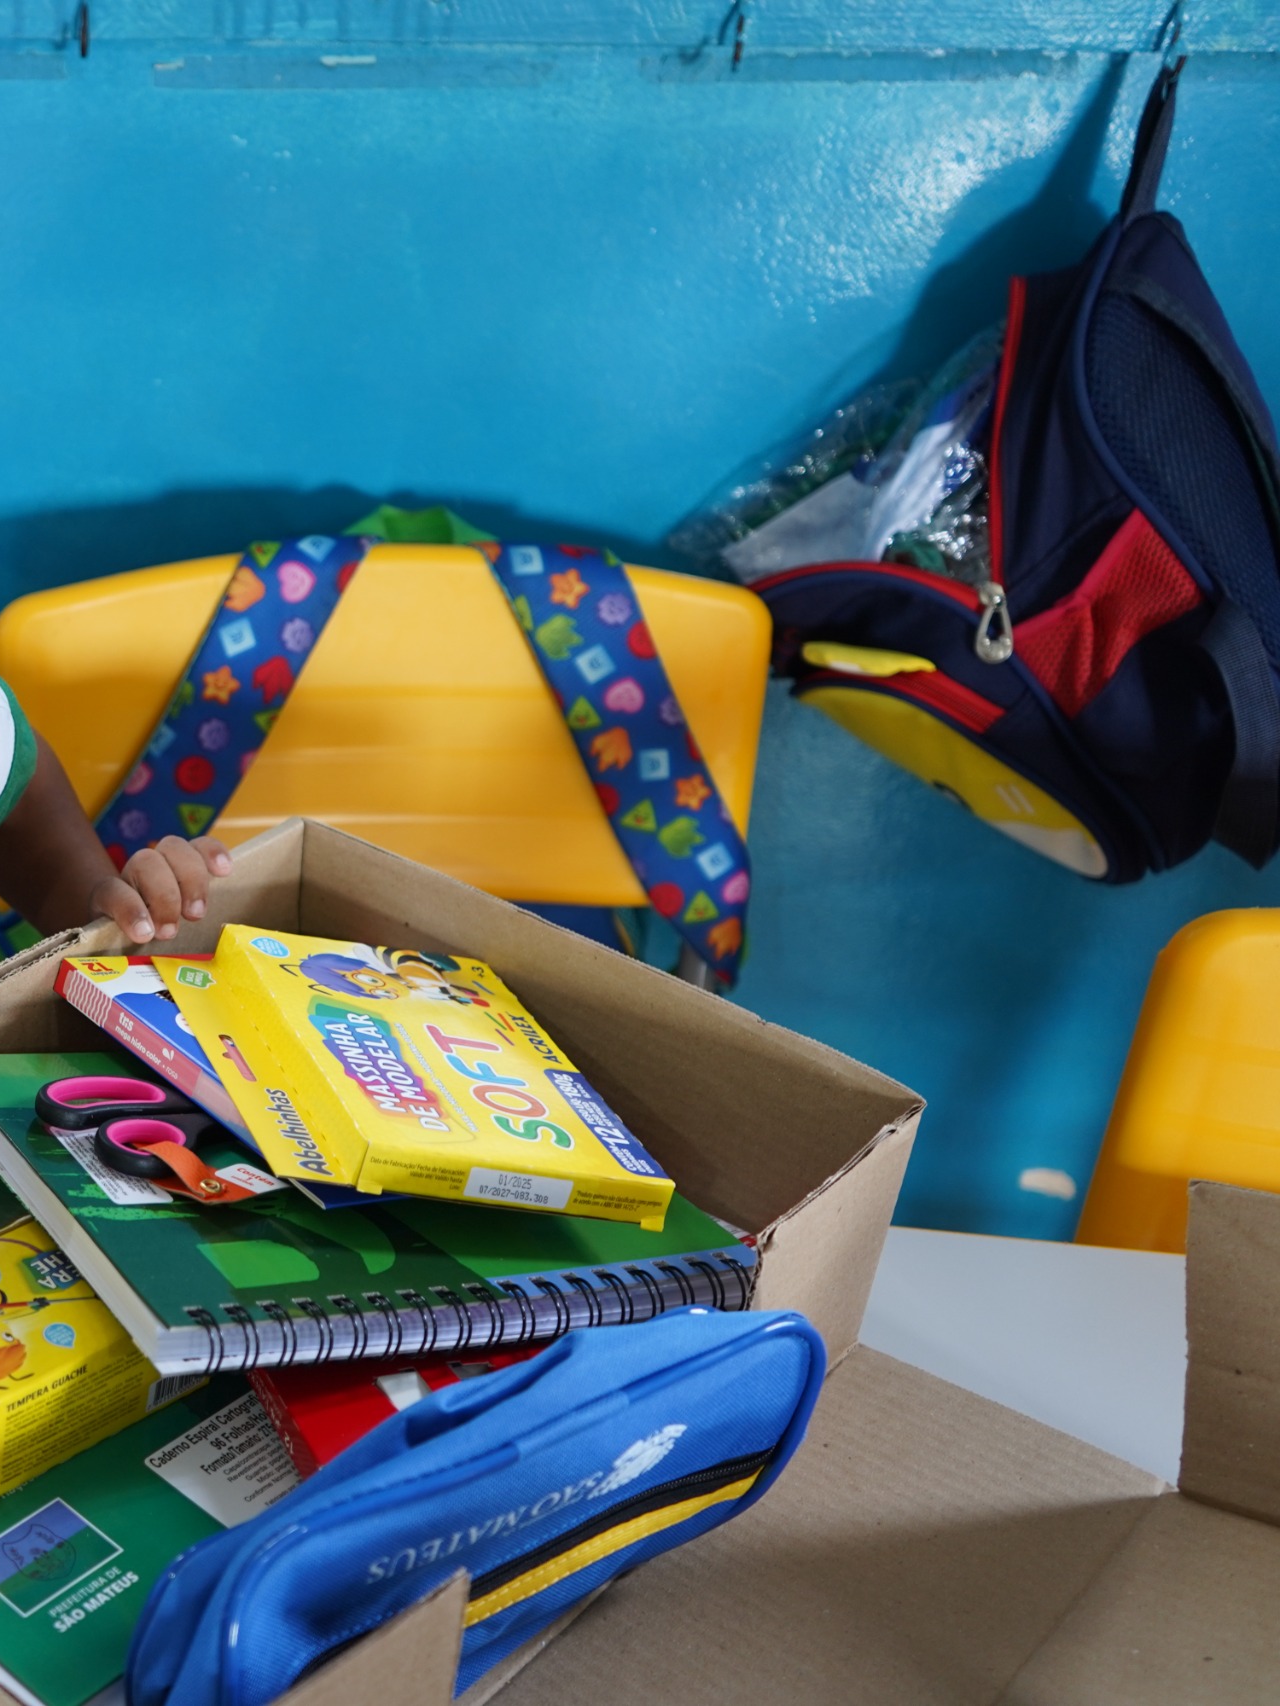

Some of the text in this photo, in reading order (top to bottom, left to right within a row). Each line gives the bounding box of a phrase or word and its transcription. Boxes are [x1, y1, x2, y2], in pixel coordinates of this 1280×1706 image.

[81, 962, 115, 973] 12
[471, 965, 486, 979] +3
[114, 1025, 132, 1042] mega
[130, 1035, 147, 1053] hidro
[145, 1049, 162, 1066] color
[507, 1012, 562, 1065] ACRILEX
[324, 1022, 408, 1113] MASSINHA
[346, 1012, 451, 1133] DE MODELAR
[424, 1023, 576, 1151] SOFT
[553, 1073, 582, 1098] 180g
[265, 1087, 335, 1177] Abelhinhas
[594, 1126, 630, 1145] 12
[236, 1167, 275, 1187] Contém
[478, 1184, 549, 1206] 07/2027-083.308
[499, 1172, 533, 1190] 01/2025
[5, 1363, 89, 1413] TEMPERA GUACHE
[148, 1440, 191, 1469] Caderno
[185, 1419, 221, 1446] Espiral
[209, 1437, 226, 1451] 96
[366, 1502, 527, 1585] MATEUS
[48, 1565, 123, 1618] PREFEITURA DE
[53, 1570, 140, 1634] SÃO MATEUS
